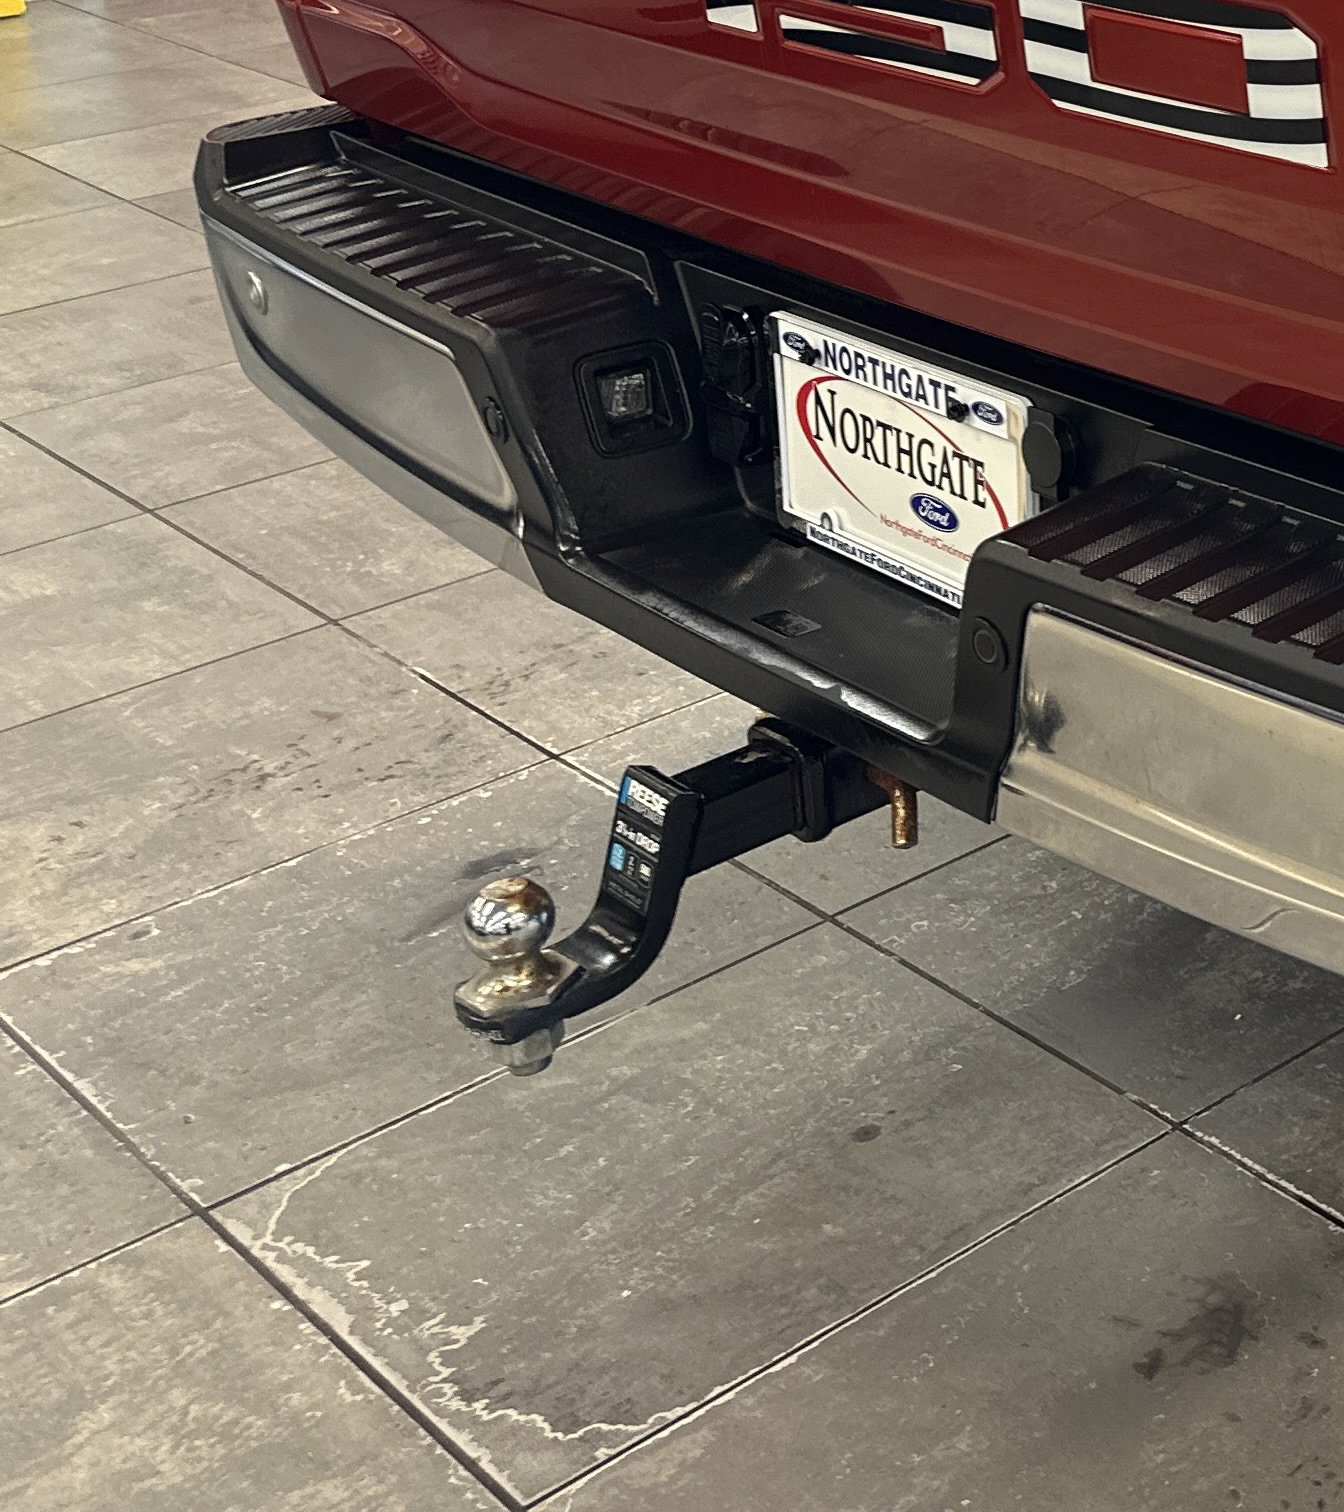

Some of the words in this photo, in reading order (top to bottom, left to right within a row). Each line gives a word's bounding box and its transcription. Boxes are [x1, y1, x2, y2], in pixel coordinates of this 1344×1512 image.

[823, 339, 957, 416] NORTHGATE
[918, 497, 951, 527] Ford
[628, 778, 670, 817] REESE
